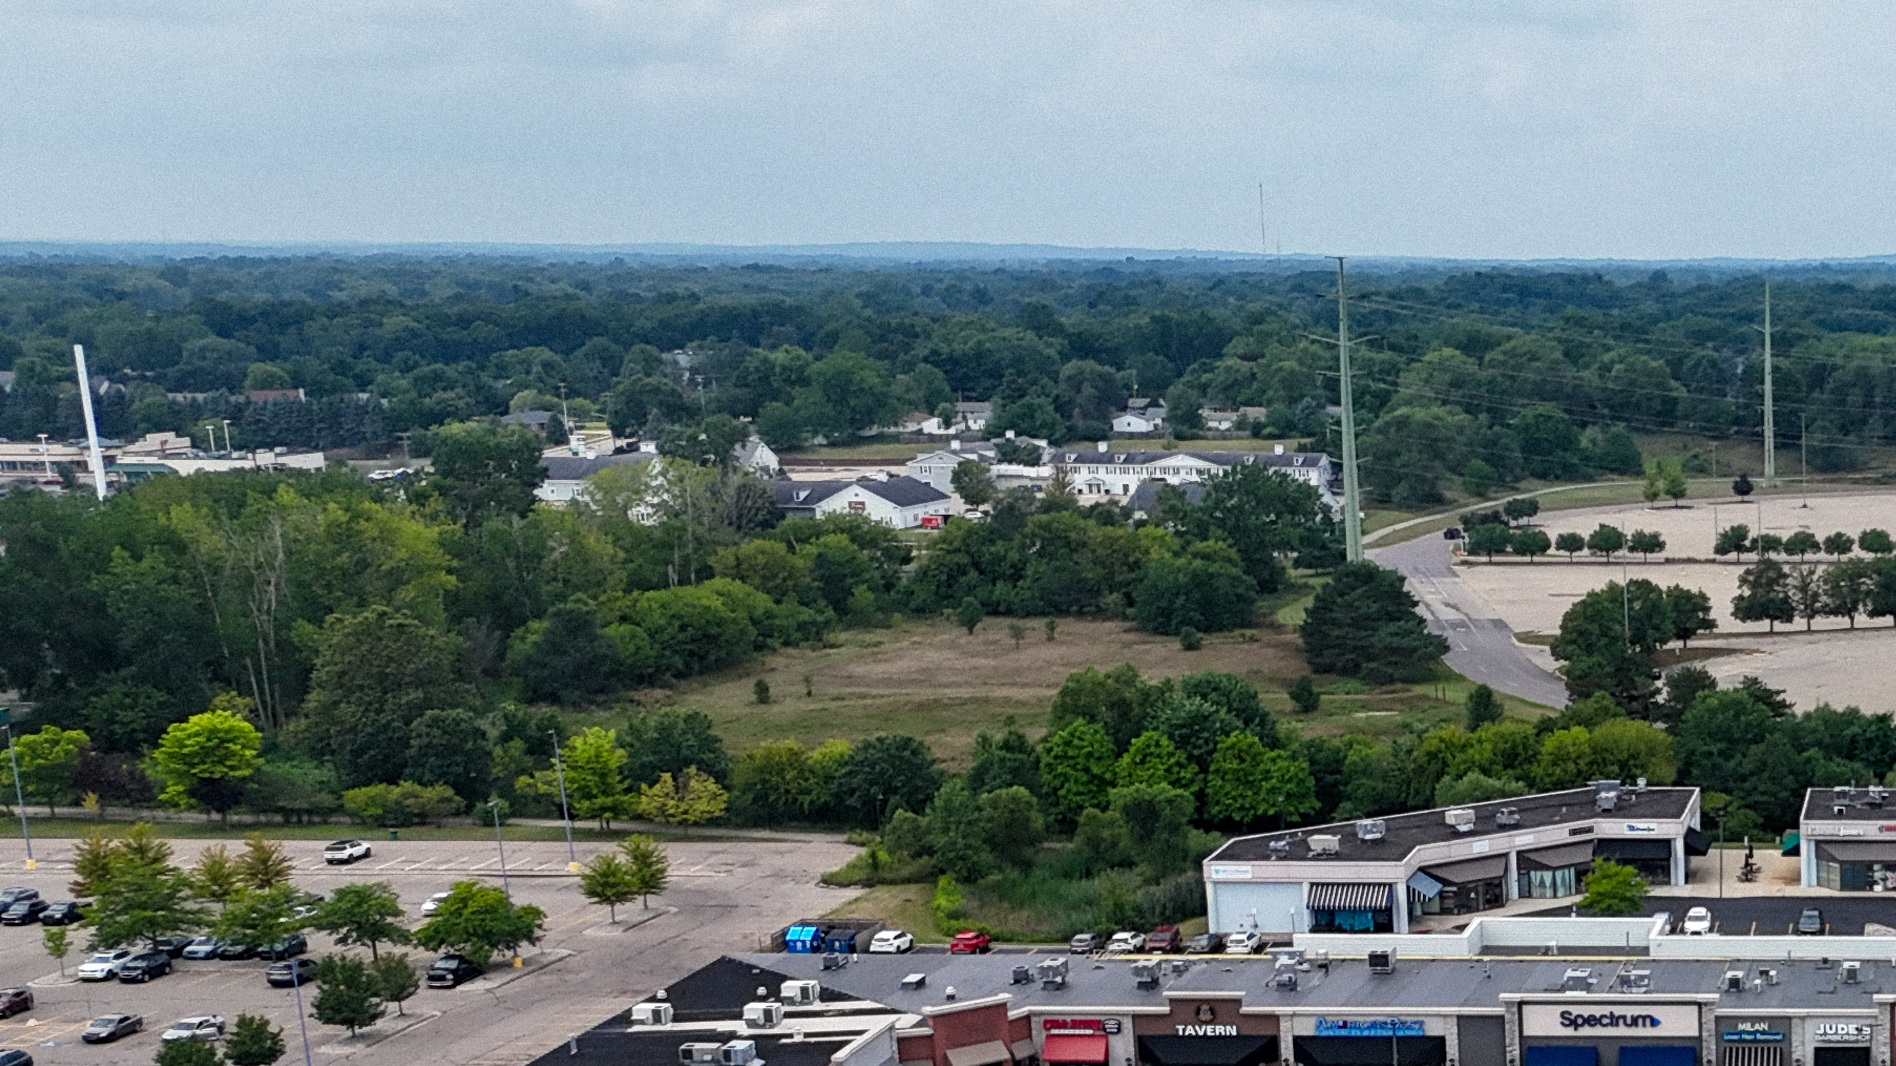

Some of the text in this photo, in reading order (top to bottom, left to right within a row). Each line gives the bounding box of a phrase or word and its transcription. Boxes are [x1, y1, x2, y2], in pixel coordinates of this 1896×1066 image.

[1559, 1010, 1655, 1031] Spectrum
[1175, 1025, 1237, 1036] TAVERN
[1737, 1022, 1769, 1031] MILAN
